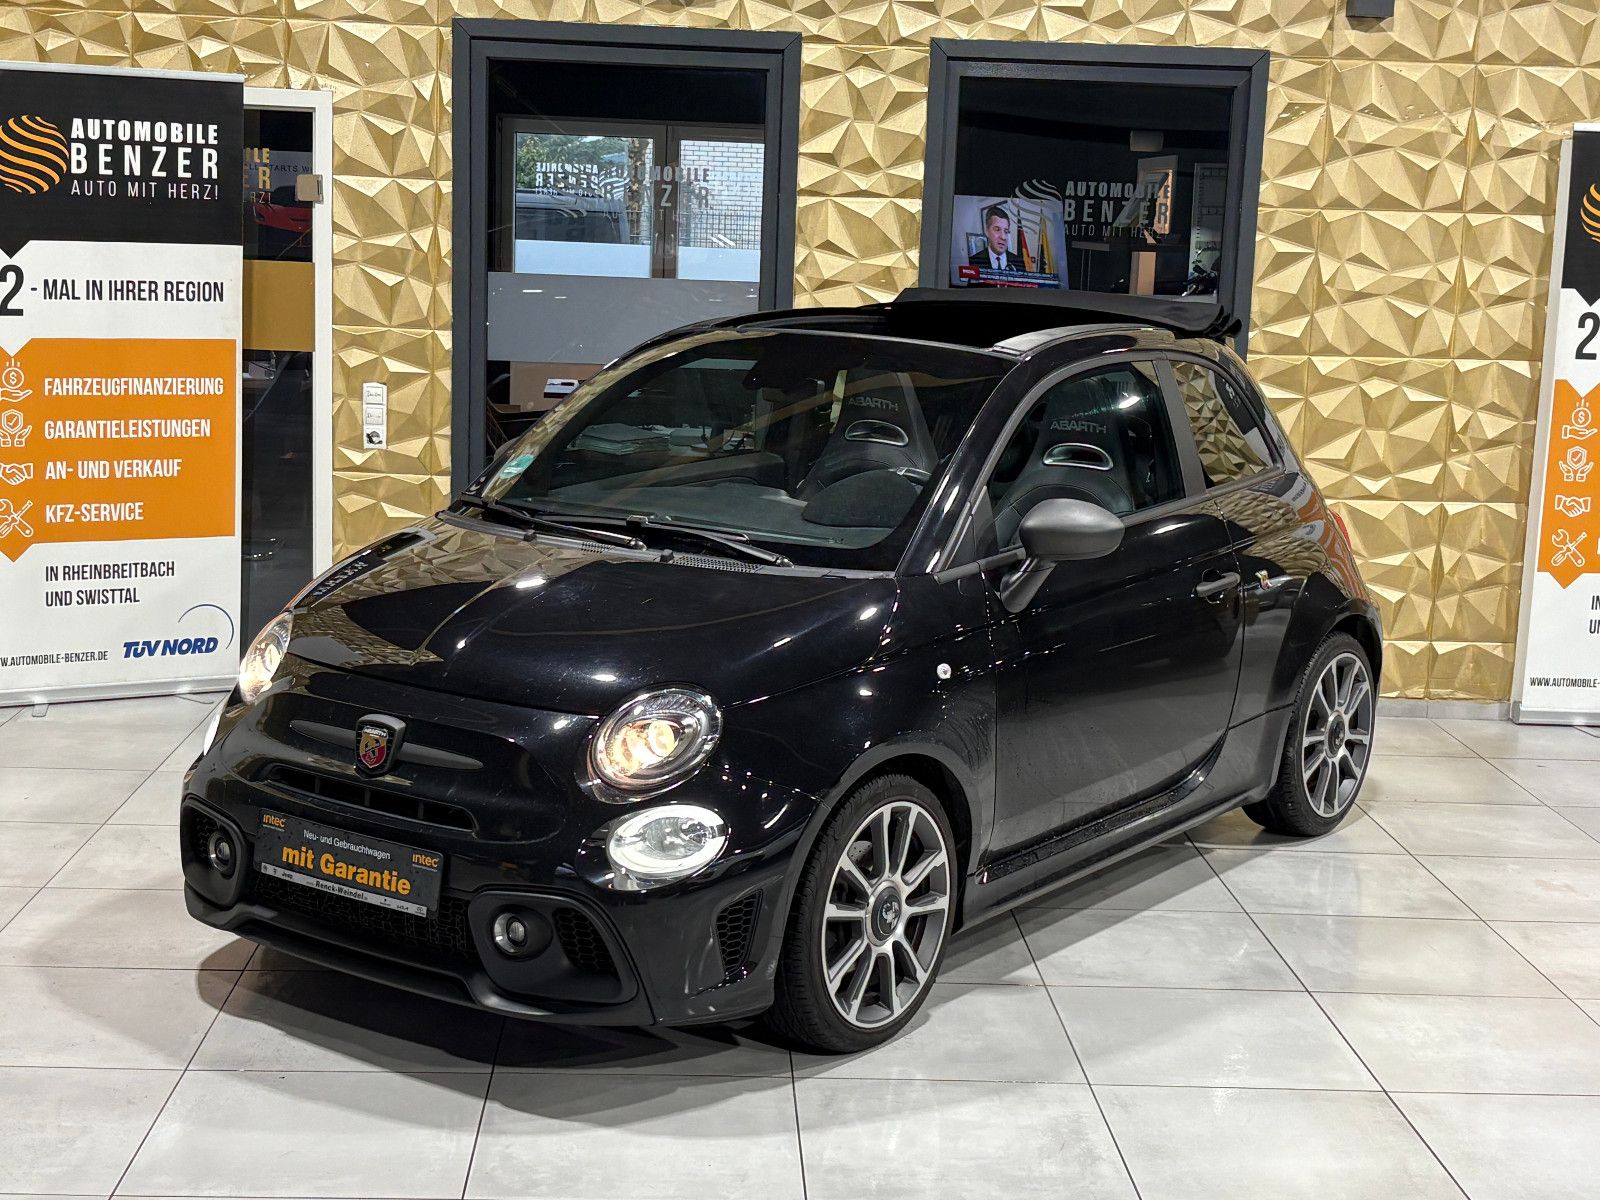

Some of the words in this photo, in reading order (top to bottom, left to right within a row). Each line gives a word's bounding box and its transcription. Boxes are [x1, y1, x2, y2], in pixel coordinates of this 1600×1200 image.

[70, 118, 219, 145] AUTOMOBILE
[70, 142, 218, 179] BENZER
[71, 180, 117, 196] AUTO
[127, 181, 157, 198] MIT
[168, 183, 219, 200] HERZ!
[0, 264, 24, 316] 2
[86, 279, 103, 301] IN
[109, 280, 158, 302] IHRER
[164, 281, 224, 303] REGION
[1575, 312, 1600, 360] 2
[44, 377, 224, 396] FAHRZEUGFINANZIERUNG
[44, 418, 211, 440] GARANTIELEISTUNGEN
[45, 461, 73, 480] AN-
[78, 460, 110, 479] UND
[114, 459, 183, 478] VERKAUF
[46, 502, 144, 523] KFZ-SERVICE
[45, 566, 58, 582] IN
[62, 561, 175, 581] RHEINBREITBACH
[45, 590, 73, 607] UND
[76, 587, 140, 606] SWISTTAL
[123, 640, 161, 659] TÜV
[161, 637, 218, 656] NORD
[262, 814, 286, 828] intec
[303, 829, 319, 841] Neu-
[320, 835, 333, 845] und
[333, 837, 391, 860] Gebrauchtwagen
[282, 846, 315, 870] mit
[319, 853, 411, 896] Garantie
[412, 853, 439, 868] intec
